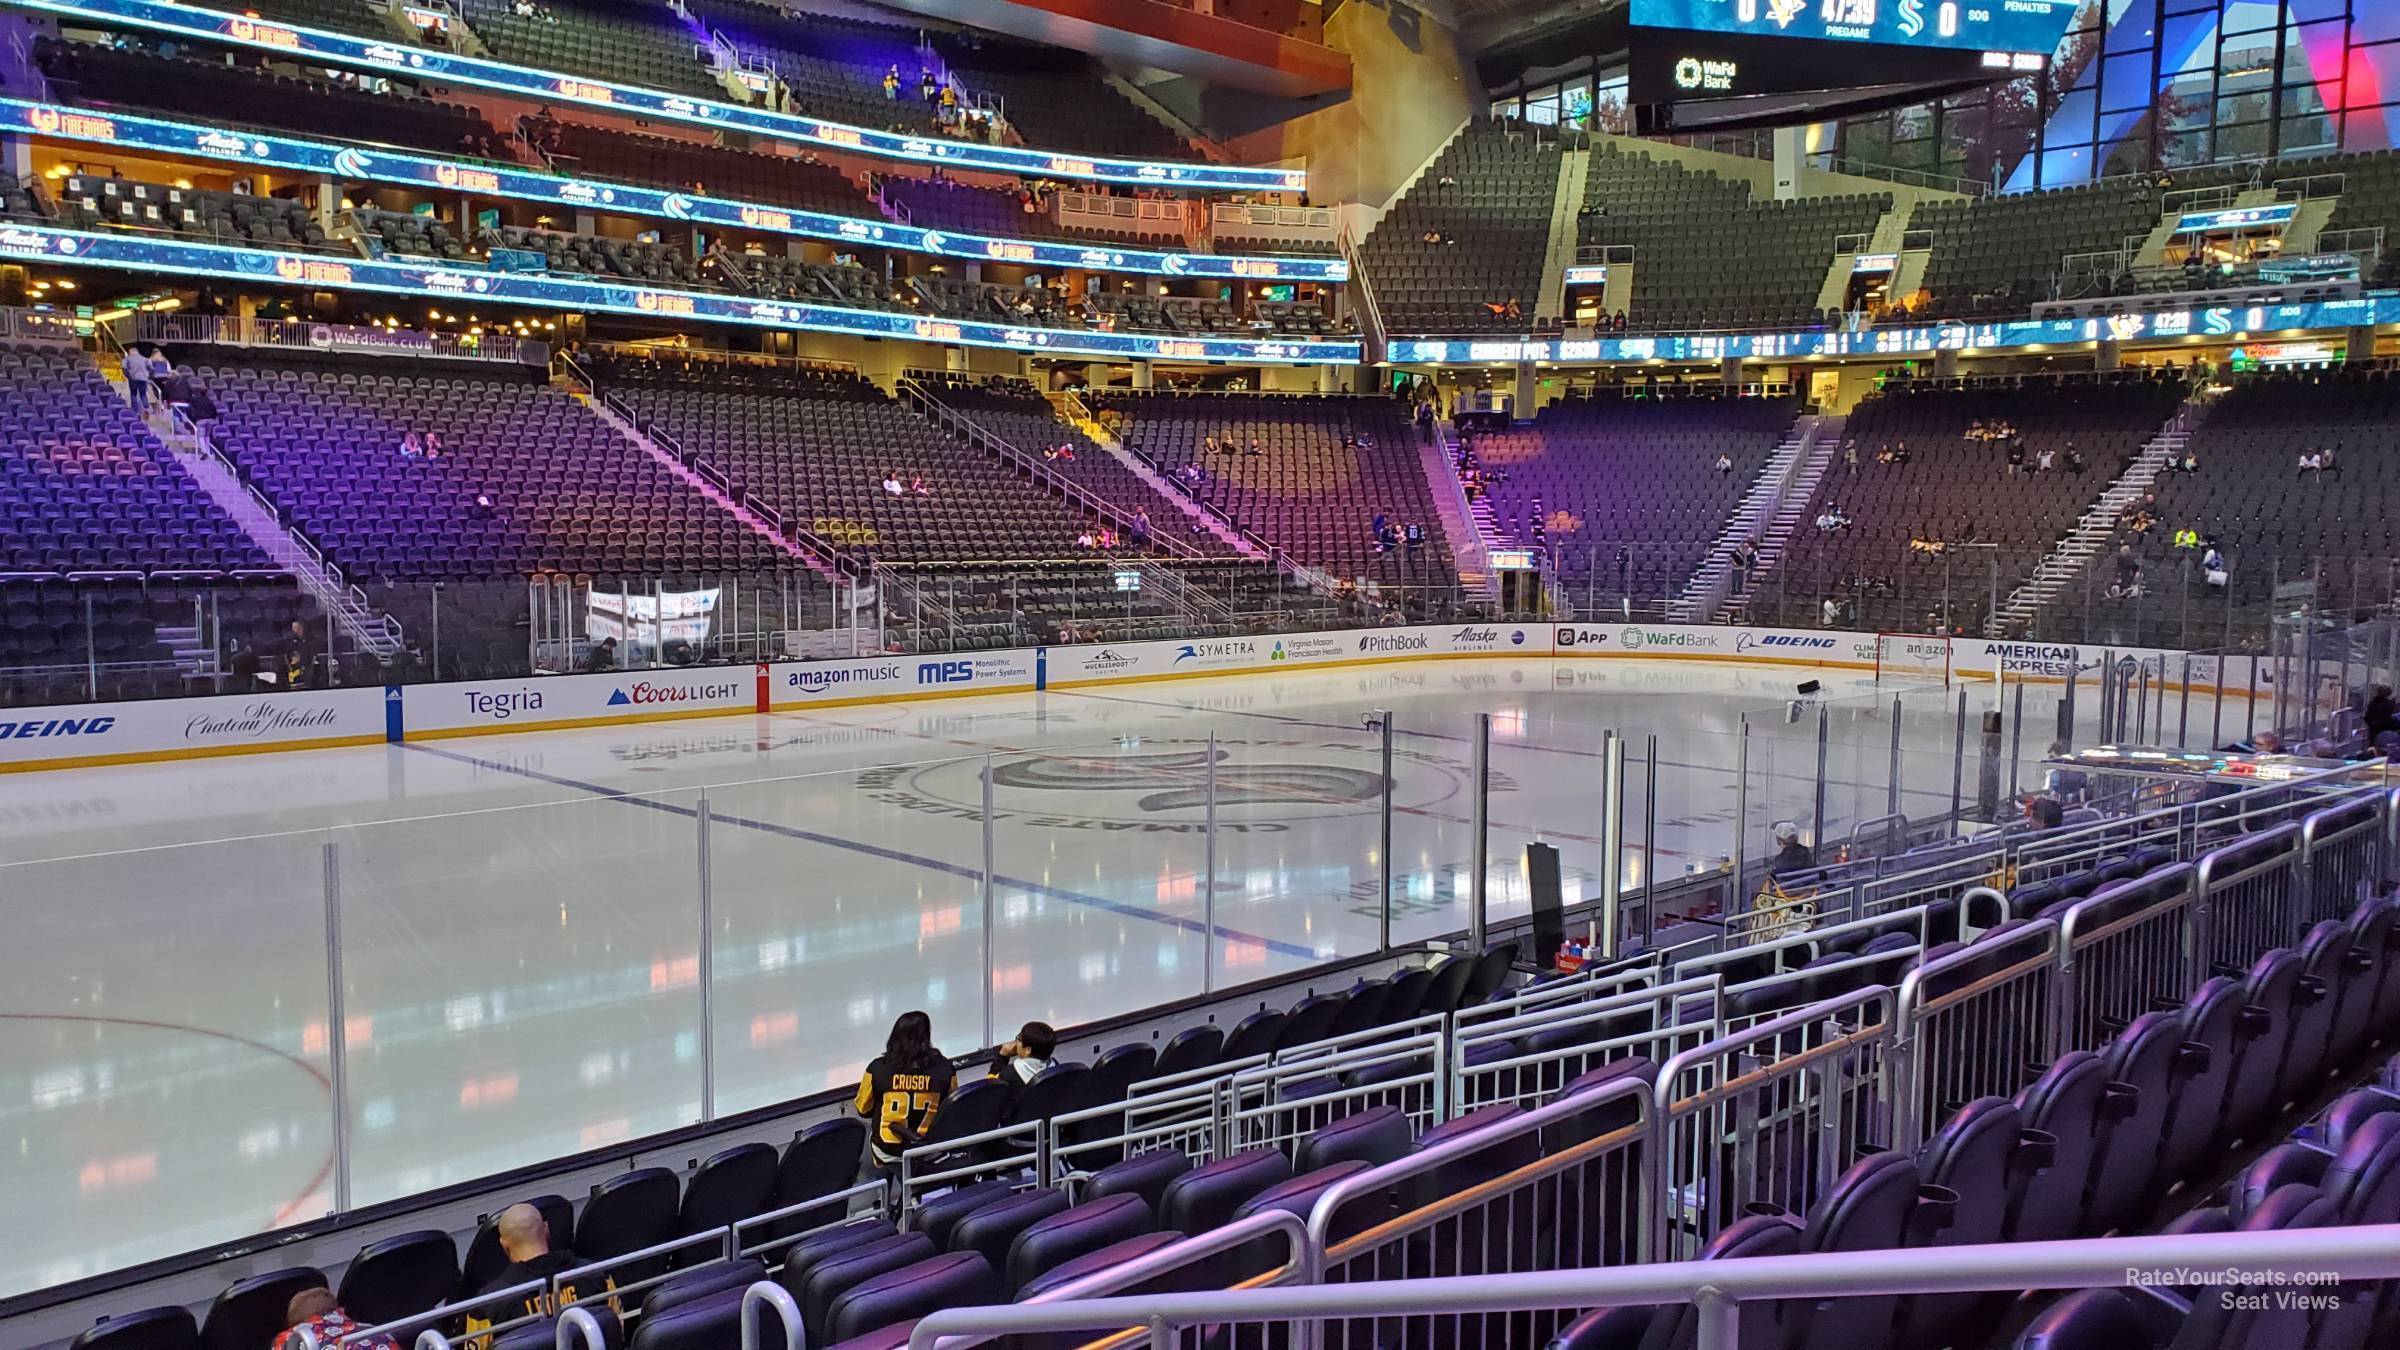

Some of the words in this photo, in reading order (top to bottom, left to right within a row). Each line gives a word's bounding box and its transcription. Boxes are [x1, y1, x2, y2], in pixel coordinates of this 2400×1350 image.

[1939, 2, 1957, 36] 0
[1968, 10, 1989, 21] SOG
[2005, 3, 2050, 13] PENALTIES
[1826, 26, 1869, 38] PREGAME
[1703, 61, 1736, 76] WaFd
[1704, 76, 1731, 88] Bank
[2280, 307, 2300, 316] SOG
[2324, 300, 2366, 309] PENALTIES
[2054, 322, 2072, 330] SOG
[2085, 320, 2097, 338] 0
[2247, 307, 2262, 329] 0
[401, 338, 432, 349] CLUB
[1288, 639, 1312, 648] Virginia
[1312, 638, 1334, 646] Mason
[1369, 633, 1428, 651] PitchBook
[1452, 627, 1498, 643] Alaska
[1761, 635, 1837, 648] BOEING
[1199, 642, 1255, 657] SYMETRA
[1288, 649, 1321, 658] Franciscan
[1322, 647, 1343, 656] Health
[853, 662, 900, 682] music
[975, 659, 1011, 669] Monolithic
[1085, 661, 1129, 670] MUCKLESHOOT
[789, 670, 850, 687] amazon
[918, 661, 973, 684] MPS
[975, 669, 998, 679] Power
[998, 667, 1027, 677] Systems
[632, 681, 688, 704] Coors
[690, 683, 738, 700] LIGHT
[245, 700, 275, 718] Ste
[464, 687, 543, 719] Tegria
[0, 717, 116, 739] OEING
[185, 712, 263, 740] Chateau
[260, 707, 338, 736] Michelle
[892, 1074, 931, 1090] CROSBY
[879, 1091, 941, 1144] 87
